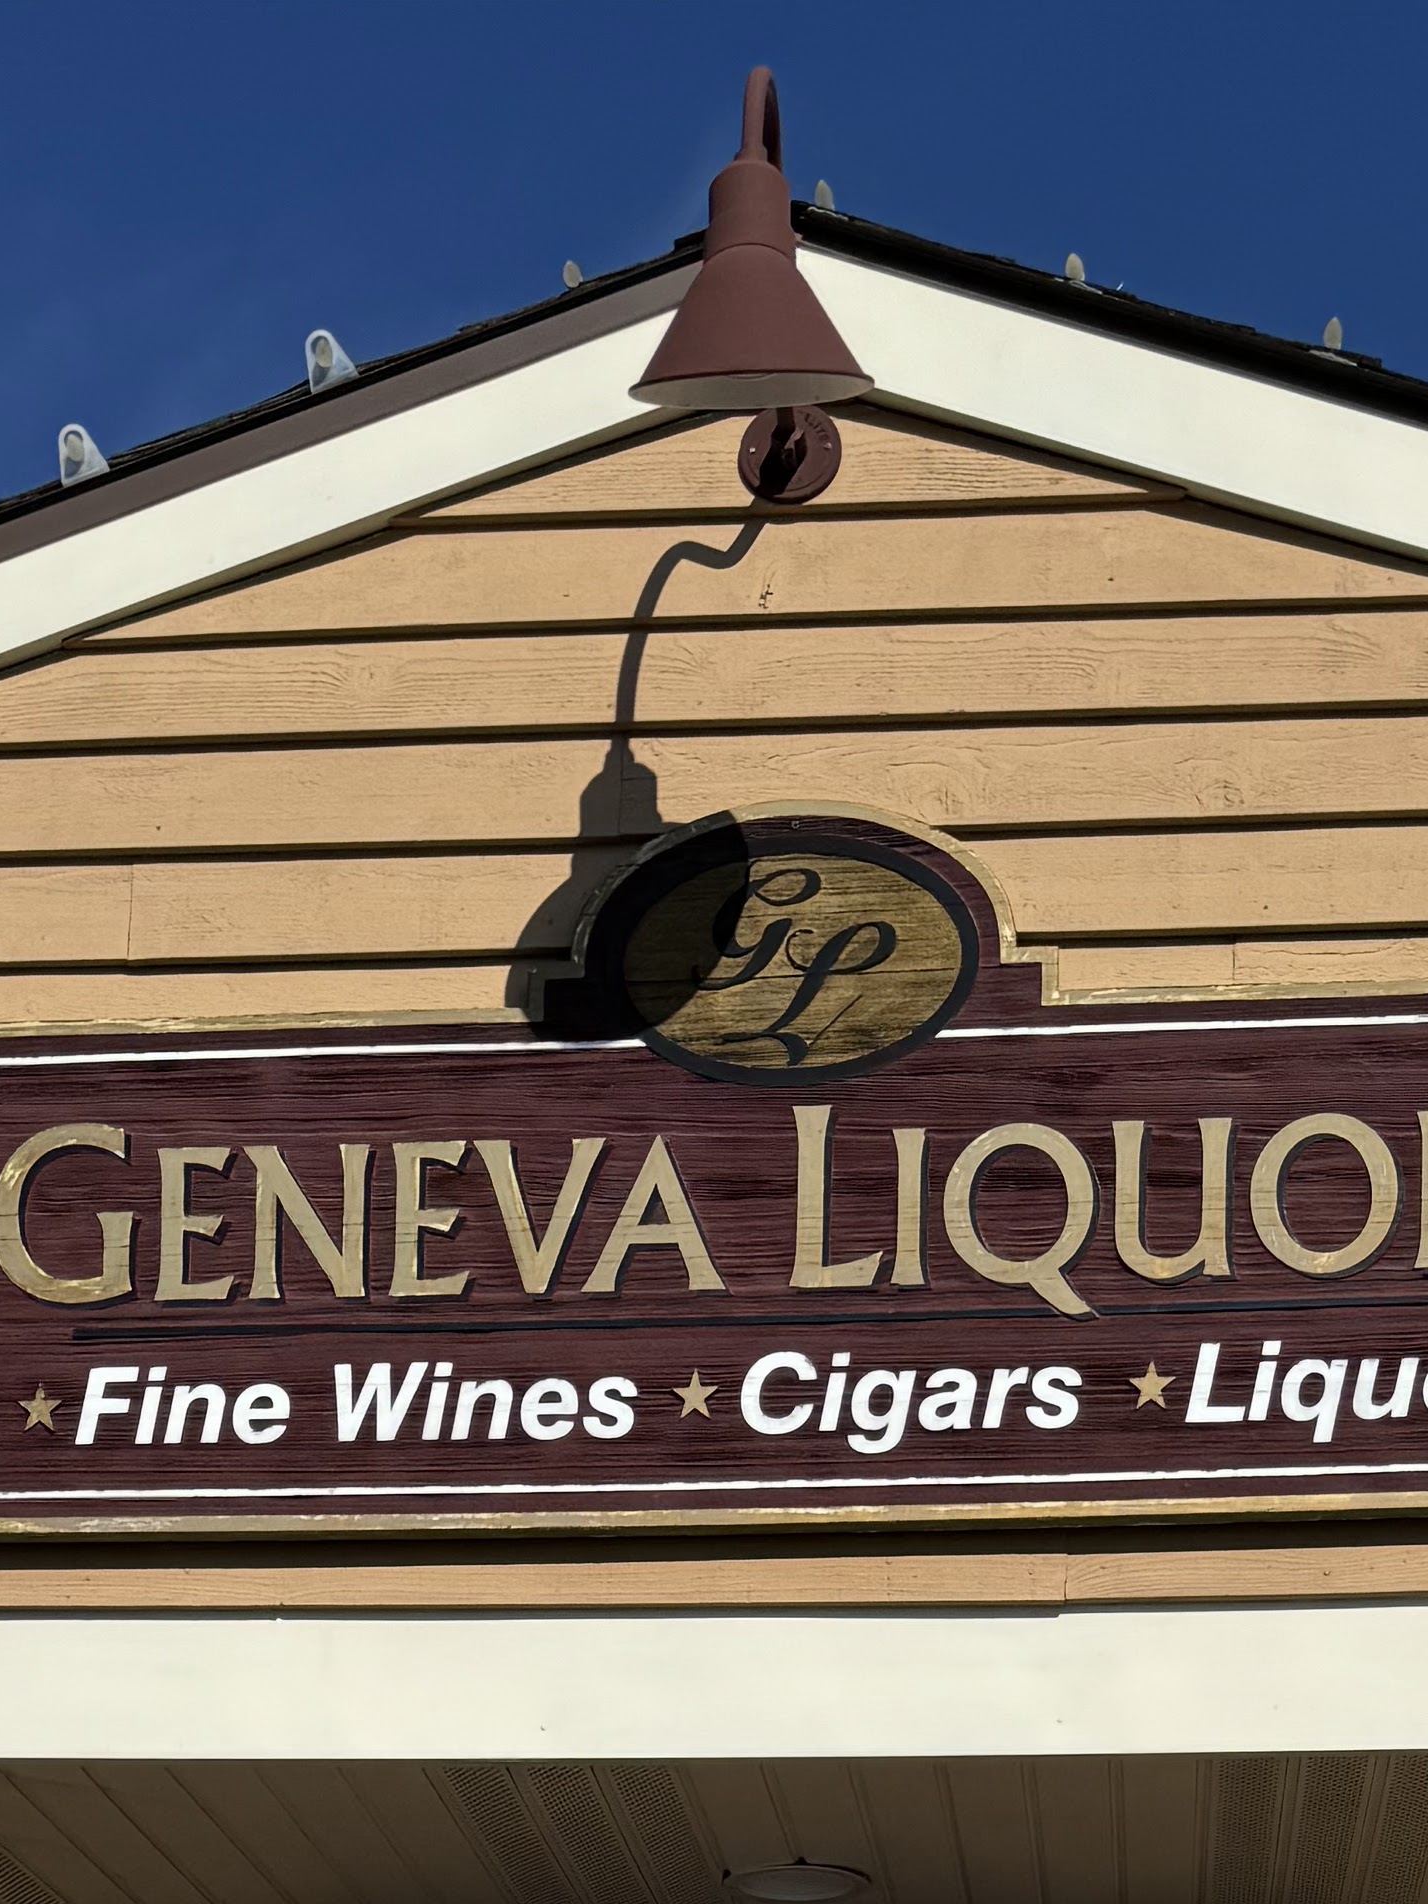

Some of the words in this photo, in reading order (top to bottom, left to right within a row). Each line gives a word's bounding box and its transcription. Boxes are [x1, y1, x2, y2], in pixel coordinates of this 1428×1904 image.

[74, 1365, 292, 1445] Fine
[333, 1361, 639, 1443] Wines
[740, 1350, 1084, 1454] Cigars
